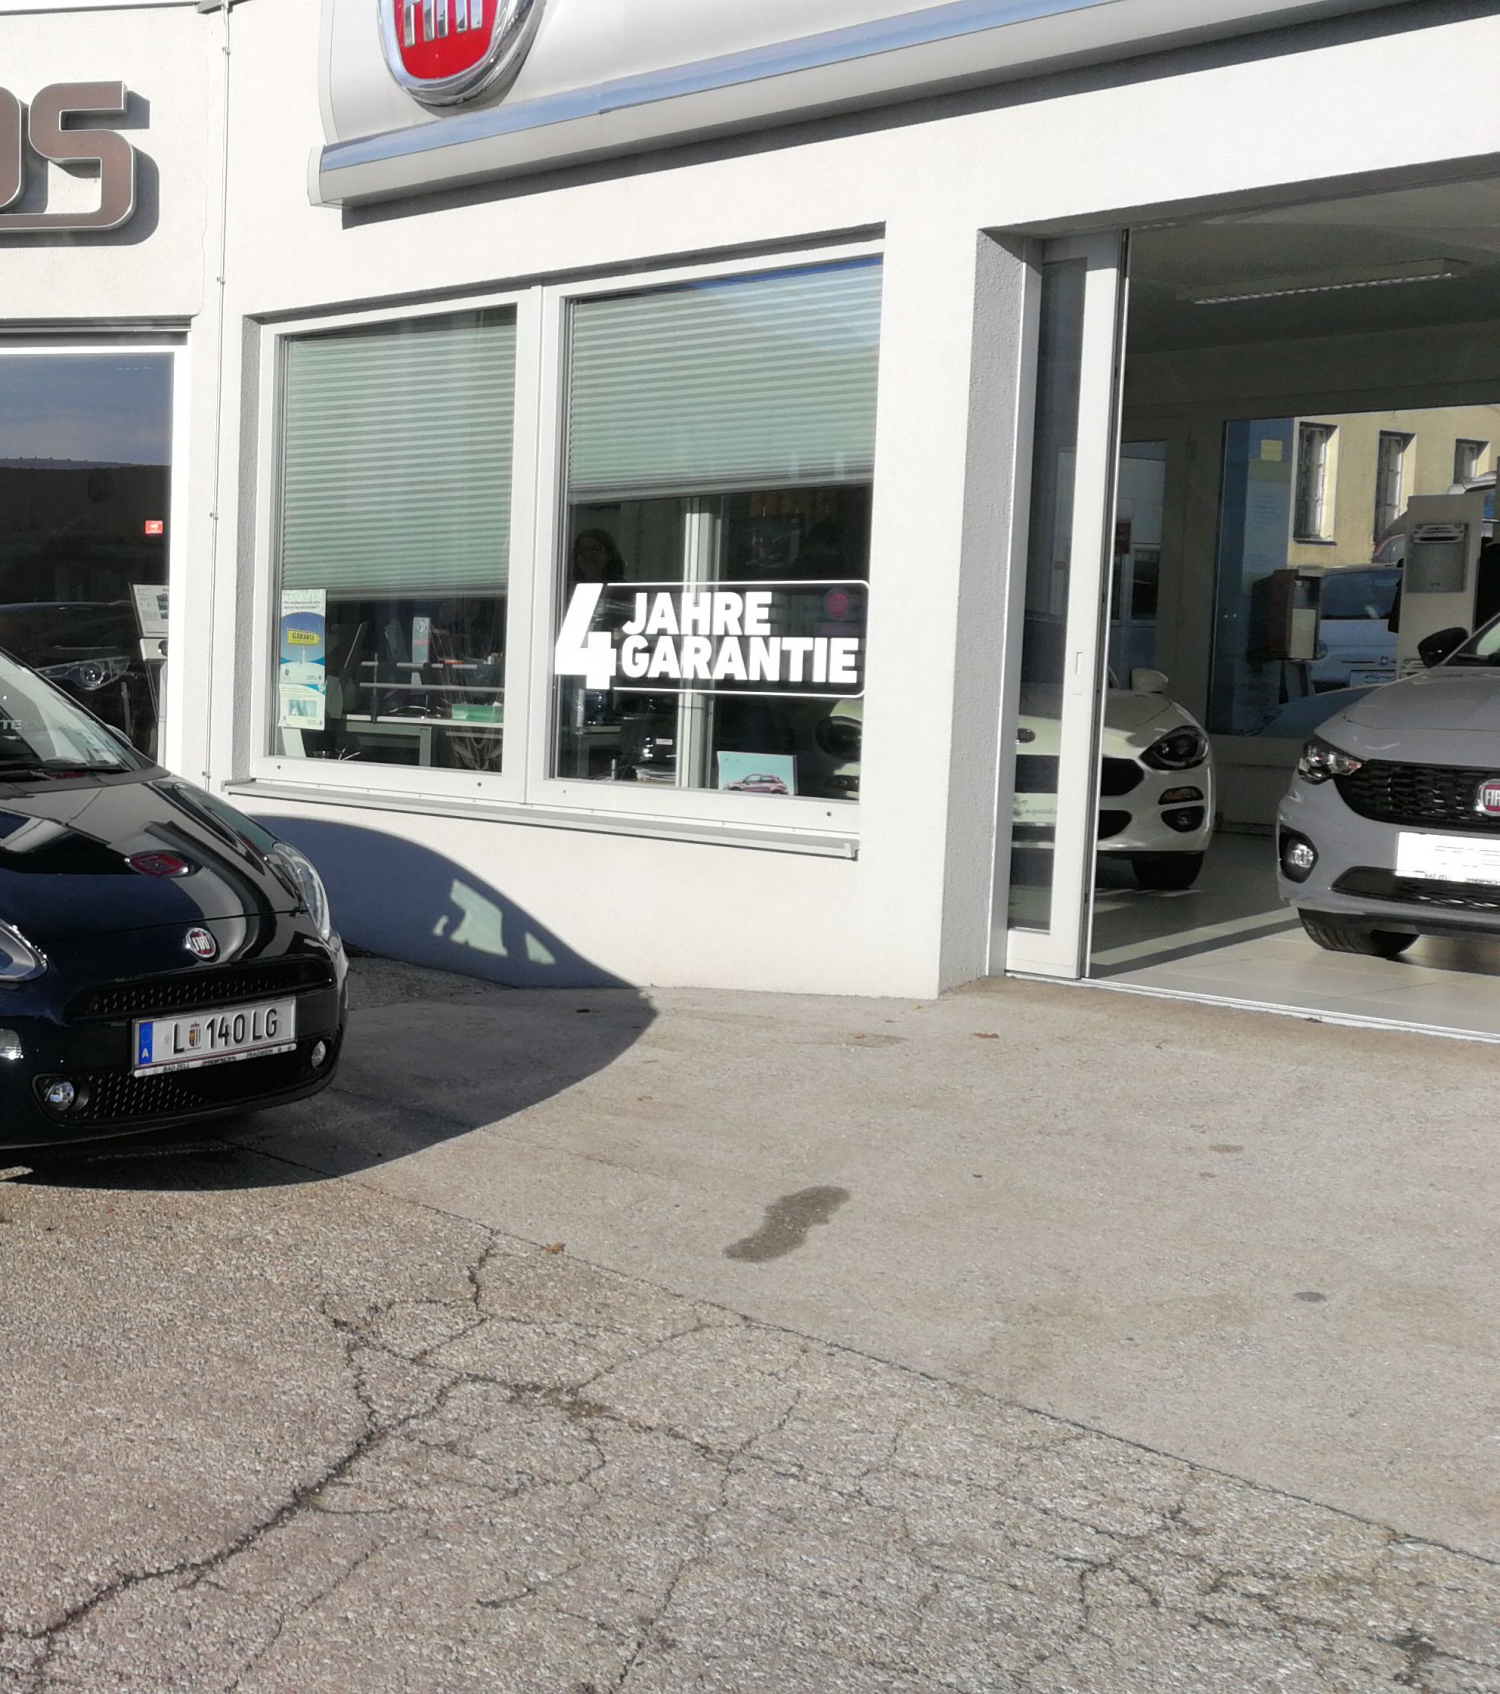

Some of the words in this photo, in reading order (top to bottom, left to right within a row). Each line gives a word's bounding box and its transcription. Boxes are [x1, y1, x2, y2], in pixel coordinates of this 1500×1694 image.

[554, 583, 617, 690] 4
[621, 591, 773, 635] JAHRE
[621, 634, 859, 684] GARANTIE
[173, 1023, 185, 1054] L
